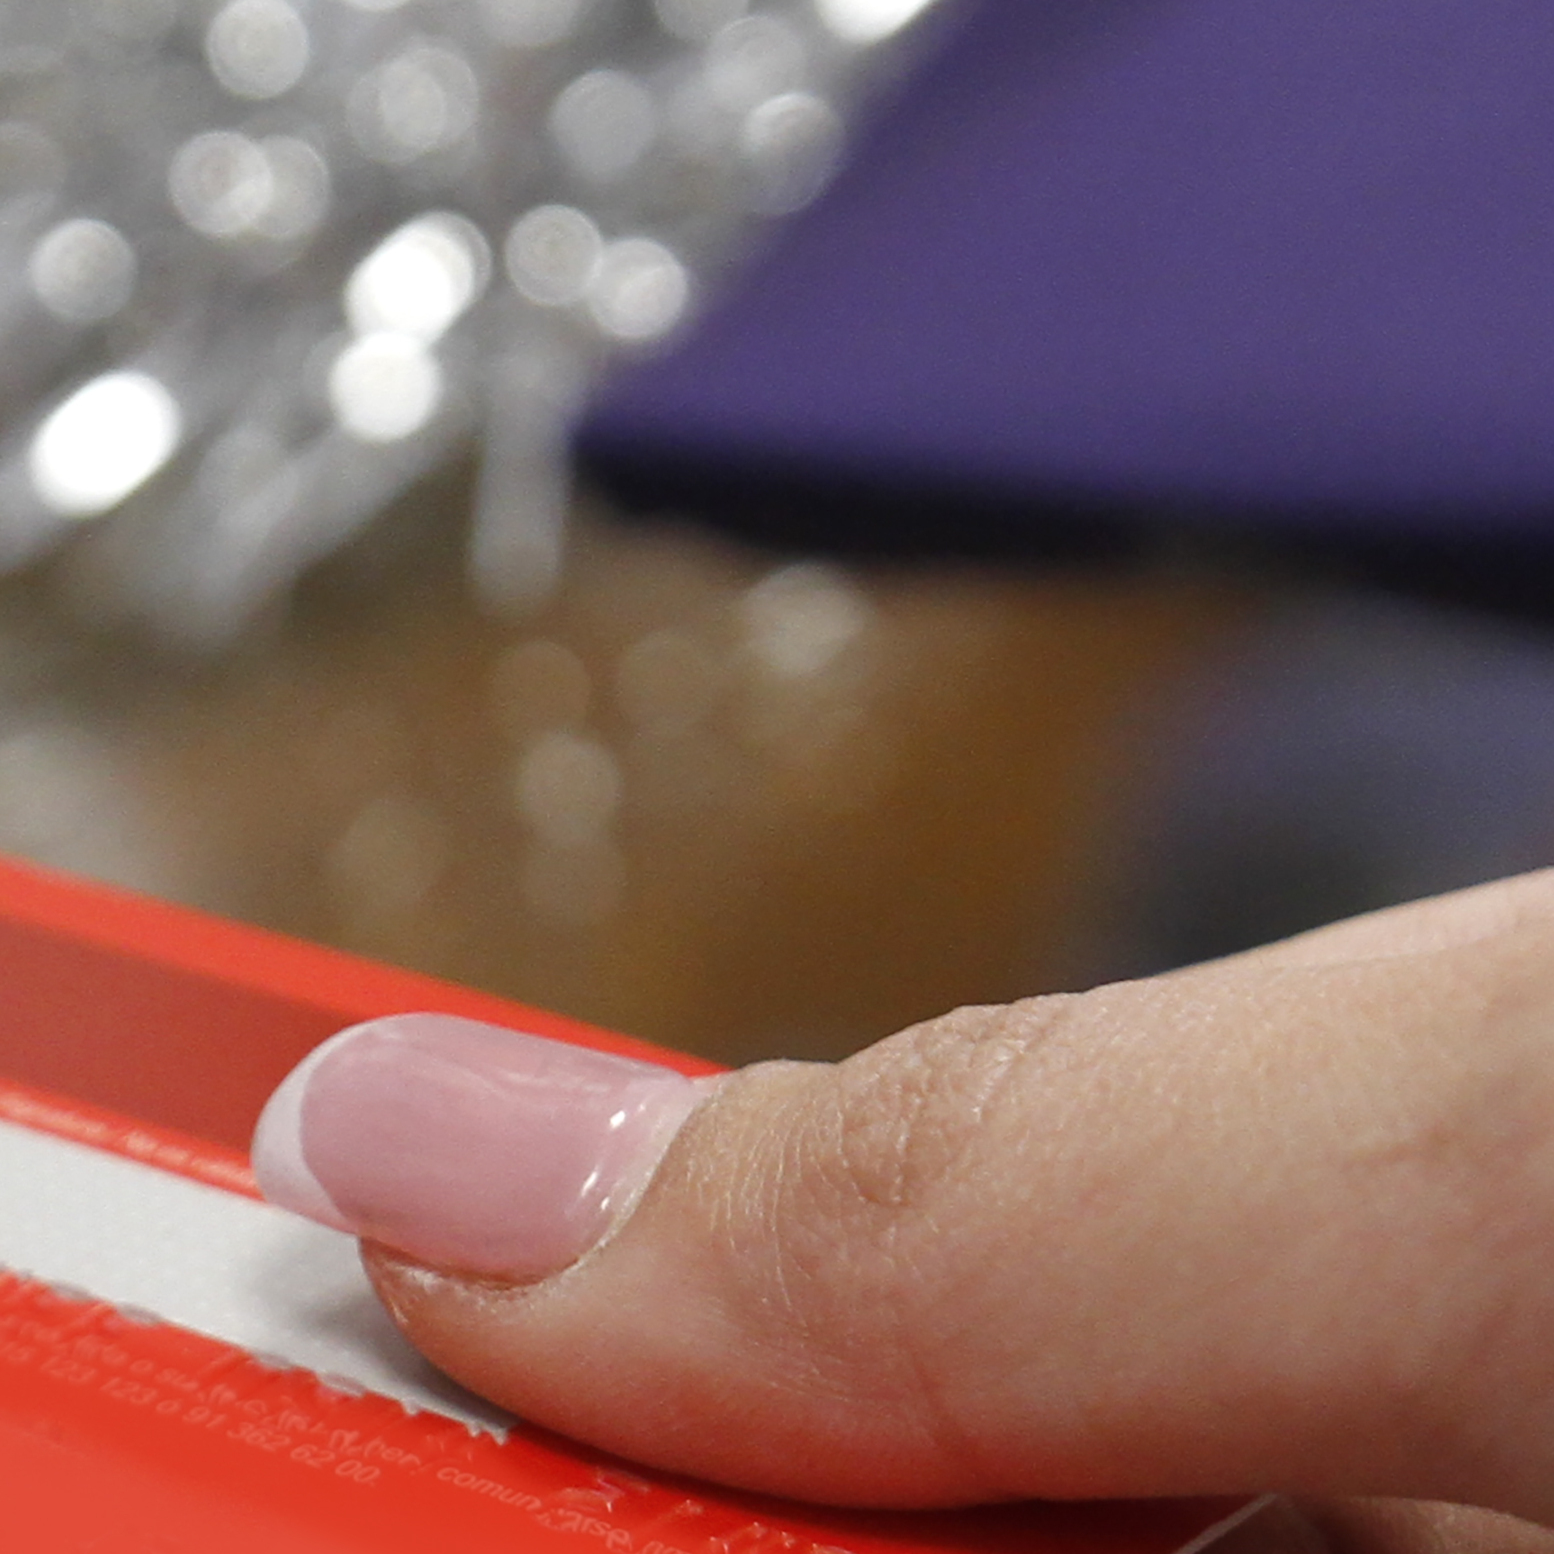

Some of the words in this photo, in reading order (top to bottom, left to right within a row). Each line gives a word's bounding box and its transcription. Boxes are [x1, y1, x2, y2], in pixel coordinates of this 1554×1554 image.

[40, 1354, 98, 1384] 123
[99, 1376, 158, 1405] 123
[182, 1405, 227, 1429] 91
[226, 1422, 291, 1452] 362
[290, 1444, 336, 1468] 62
